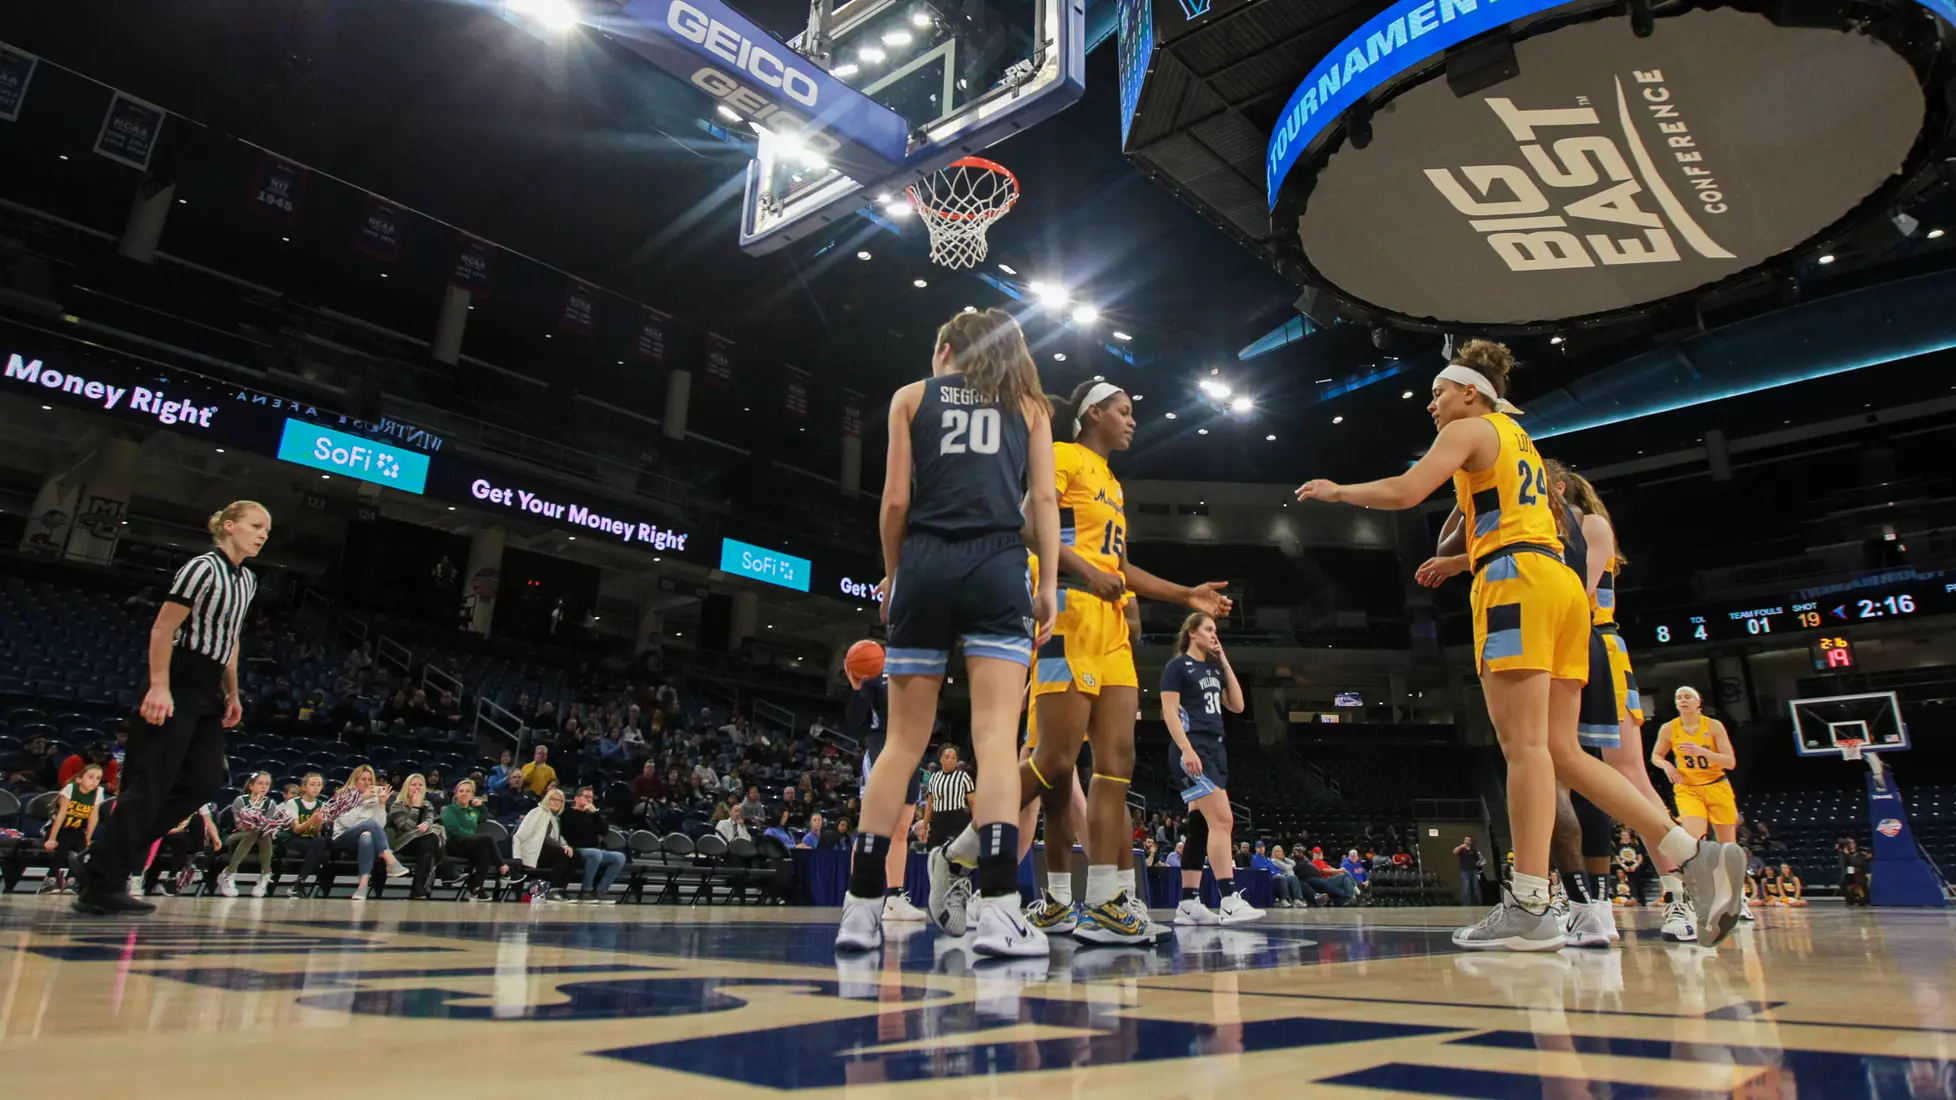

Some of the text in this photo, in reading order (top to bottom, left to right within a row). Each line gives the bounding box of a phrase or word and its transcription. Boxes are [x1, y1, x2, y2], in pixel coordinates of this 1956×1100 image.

[667, 0, 818, 107] GEICO
[1270, 0, 1499, 173] TOURNAMEN
[113, 118, 149, 137] NCAA
[1632, 69, 1729, 214] CONFERENCE
[1484, 98, 1681, 264] EAST
[257, 189, 293, 212] 1945
[1423, 165, 1595, 271] BIG
[4, 353, 128, 410] Money
[940, 408, 1001, 456] 20
[313, 437, 372, 471] SoFi
[1518, 459, 1547, 505] 24
[472, 479, 512, 506] Get
[518, 490, 565, 519] Your
[568, 504, 635, 542] Money
[1100, 520, 1123, 556] 15
[742, 551, 776, 575] SoFi
[840, 577, 867, 598] Get
[1729, 607, 1783, 620] TEAM FOULS
[1792, 602, 1817, 612] SHOT
[1857, 595, 1915, 618] 2:16
[1690, 616, 1706, 624] TOL
[1747, 618, 1770, 635] 01
[1799, 612, 1821, 628] 19
[1657, 626, 1670, 643] 8
[1694, 624, 1707, 640] 4
[1827, 648, 1850, 667] 19
[1204, 692, 1221, 714] 30
[1684, 755, 1708, 769] 30
